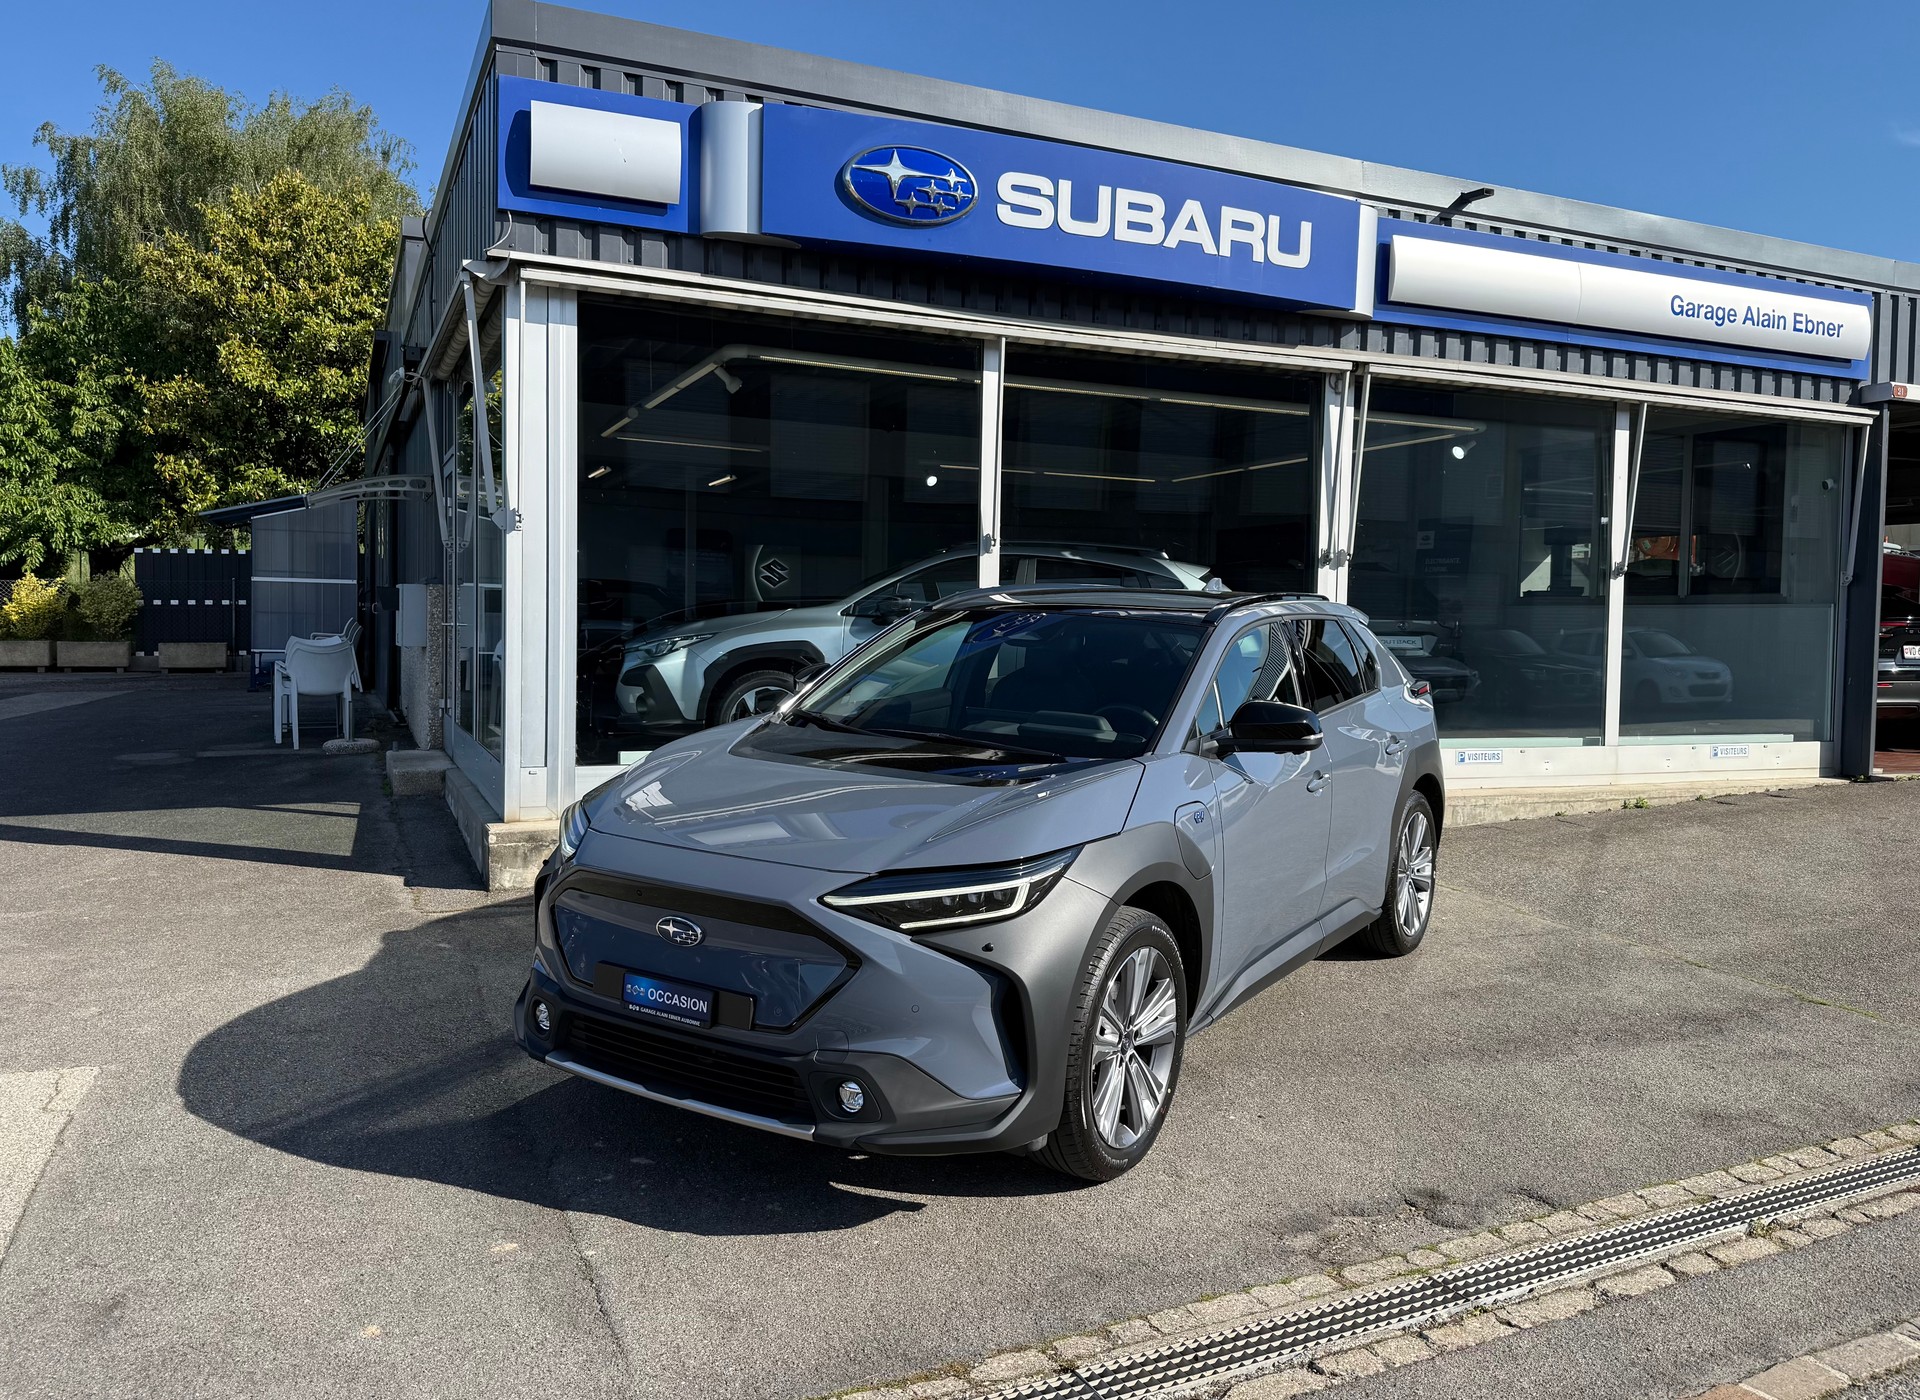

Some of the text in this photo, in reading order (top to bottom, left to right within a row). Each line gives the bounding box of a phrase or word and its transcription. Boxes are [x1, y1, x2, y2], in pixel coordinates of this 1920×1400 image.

[997, 171, 1313, 269] SUBARU
[1670, 294, 1844, 338] Garage Alain Ebner
[1467, 752, 1500, 761] VISITEURS
[1720, 747, 1747, 755] VISITEURS
[647, 988, 708, 1013] OCCASION
[640, 1006, 656, 1015] GARAGE
[668, 1013, 681, 1021] EBNER
[681, 1017, 701, 1026] AUBONNE
